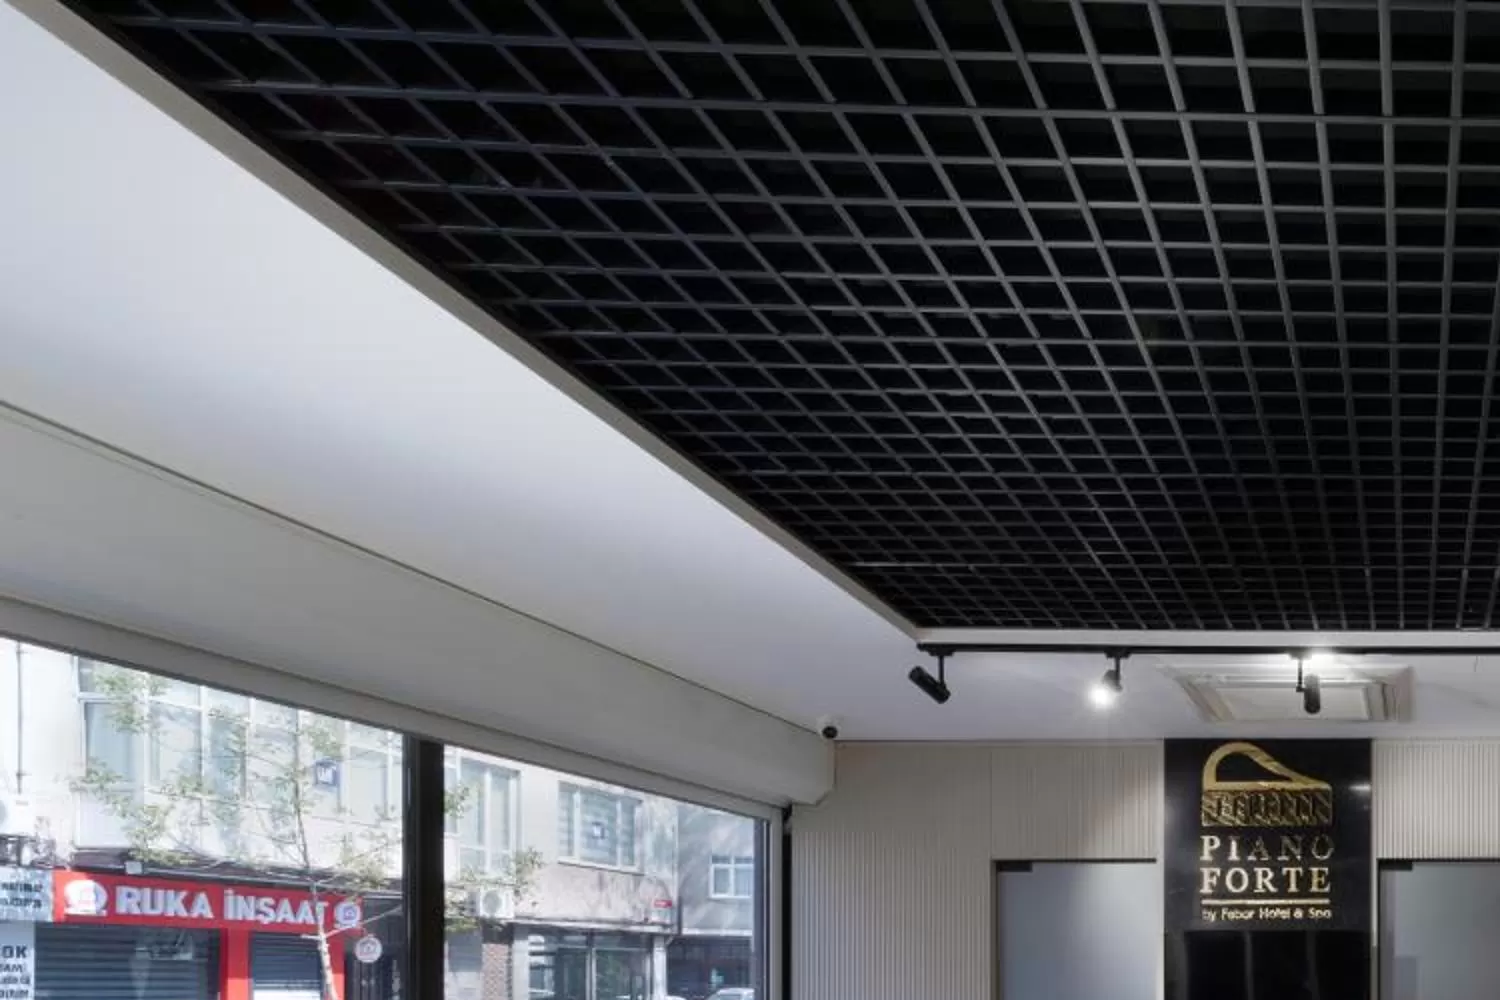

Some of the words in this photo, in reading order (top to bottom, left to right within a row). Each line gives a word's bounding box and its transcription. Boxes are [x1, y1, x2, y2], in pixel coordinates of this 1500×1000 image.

[1200, 835, 1334, 861] PIANO
[1200, 867, 1331, 893] FORTE
[115, 885, 213, 919] RUKA
[223, 889, 329, 924] İNŞAAT
[1203, 909, 1216, 922] by
[1259, 907, 1291, 919] Hotel
[1308, 907, 1332, 919] Spa
